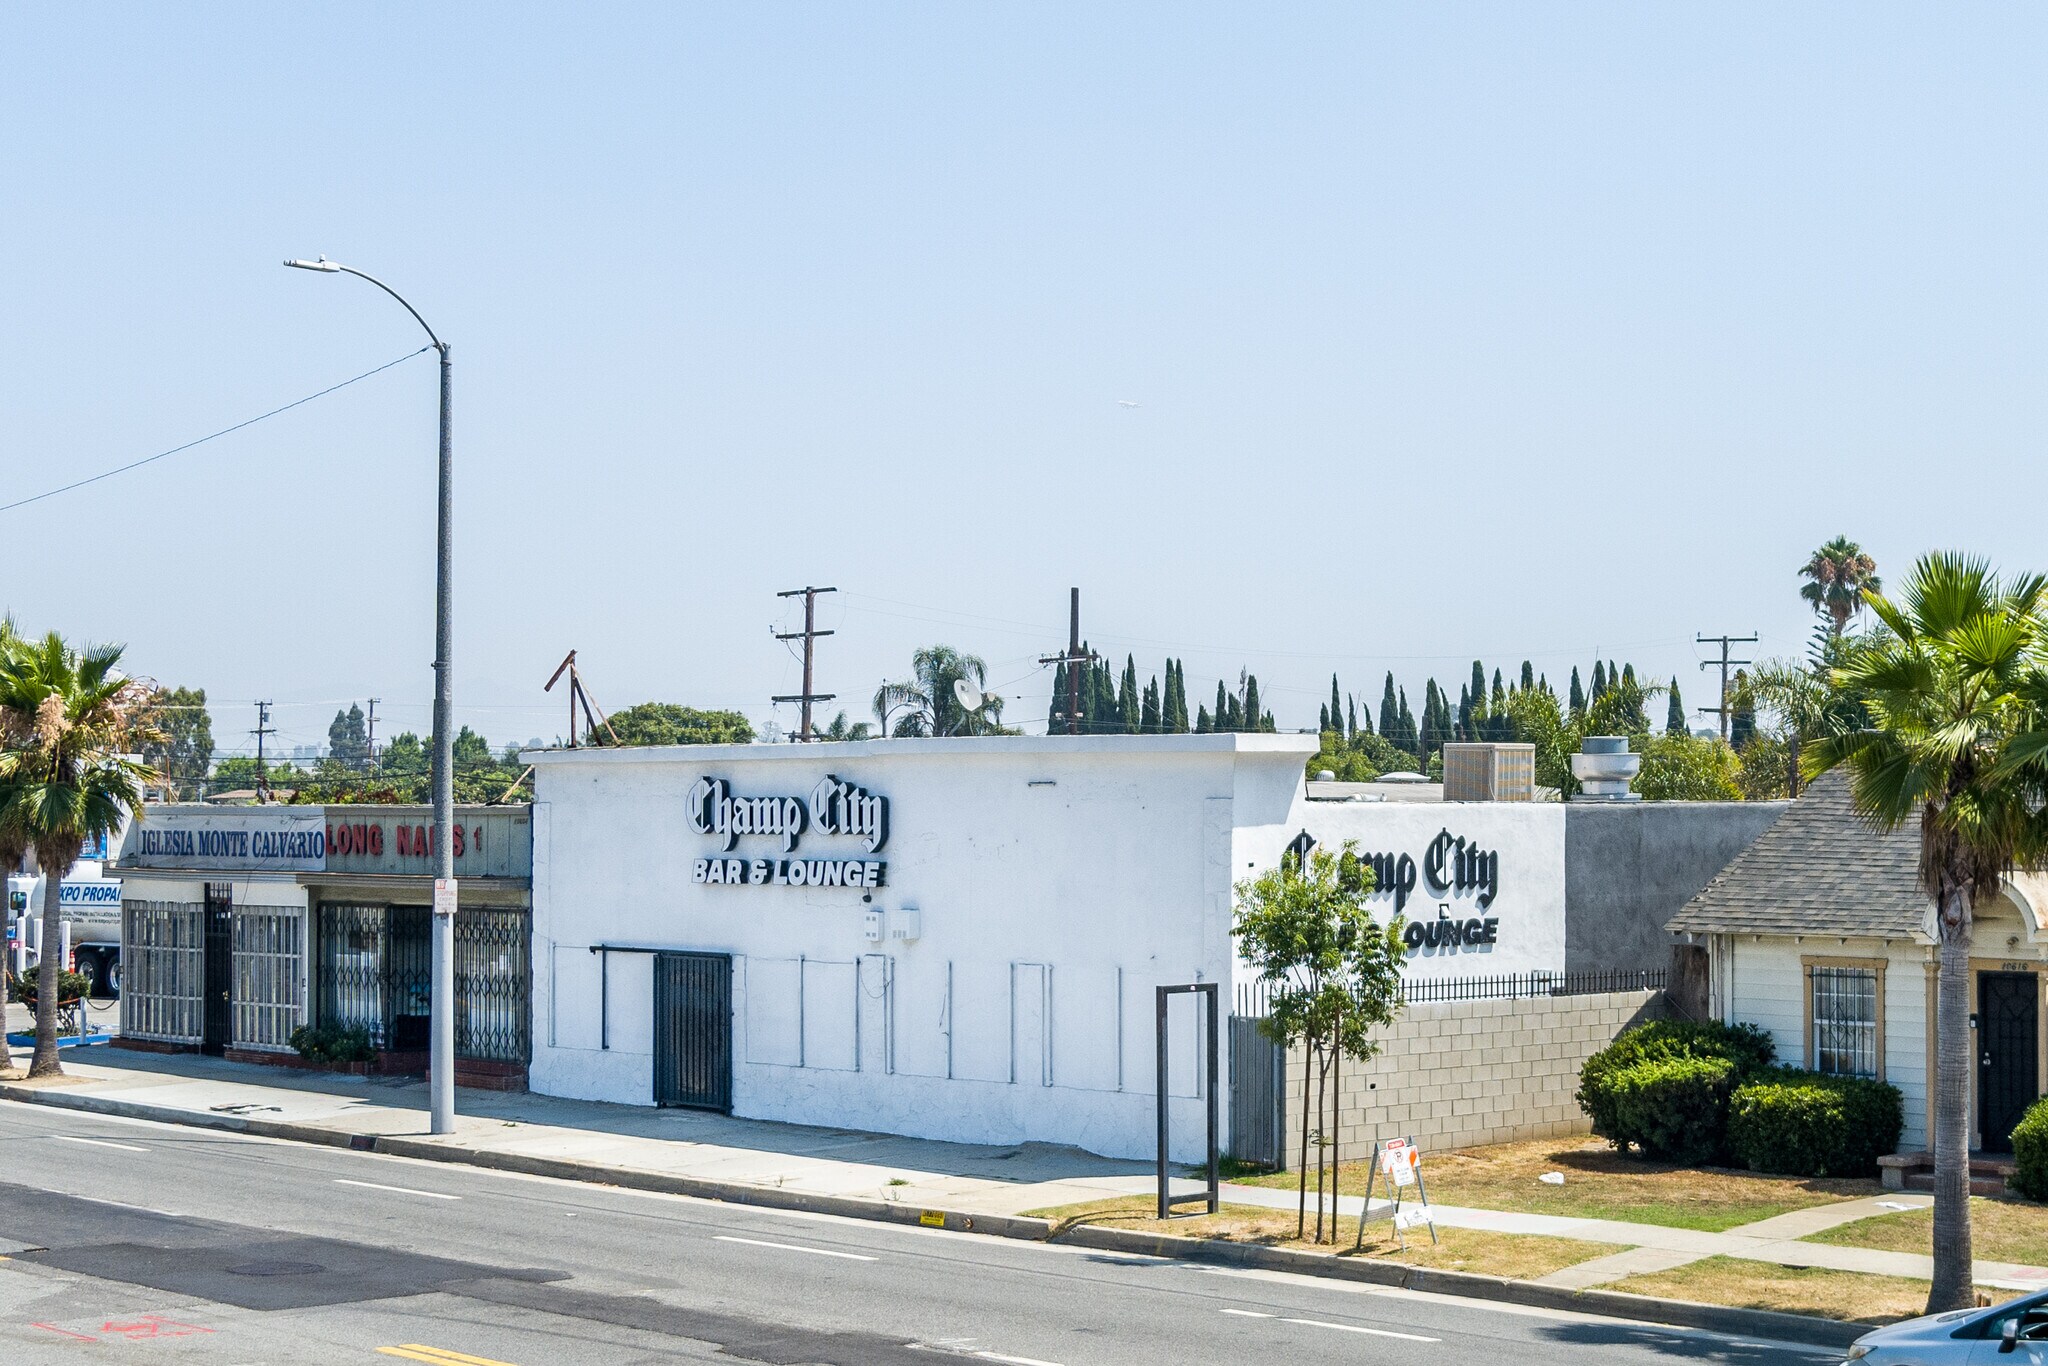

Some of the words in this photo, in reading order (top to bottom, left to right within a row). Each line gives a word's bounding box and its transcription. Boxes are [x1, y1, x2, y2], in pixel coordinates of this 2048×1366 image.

[685, 775, 810, 852] Champ
[808, 773, 889, 853] City
[141, 829, 195, 856] IGLESIA
[197, 830, 248, 857] MONTE
[252, 830, 326, 859] CALVARIO
[325, 823, 384, 857] LONG
[396, 824, 466, 857] NAIS
[692, 858, 750, 885] BAR
[749, 859, 773, 885] &
[772, 859, 887, 888] LOUNGE
[1424, 827, 1498, 909] City
[60, 886, 81, 901] XPO
[1390, 917, 1499, 949] OUNGE
[2001, 962, 2029, 971] 10616
